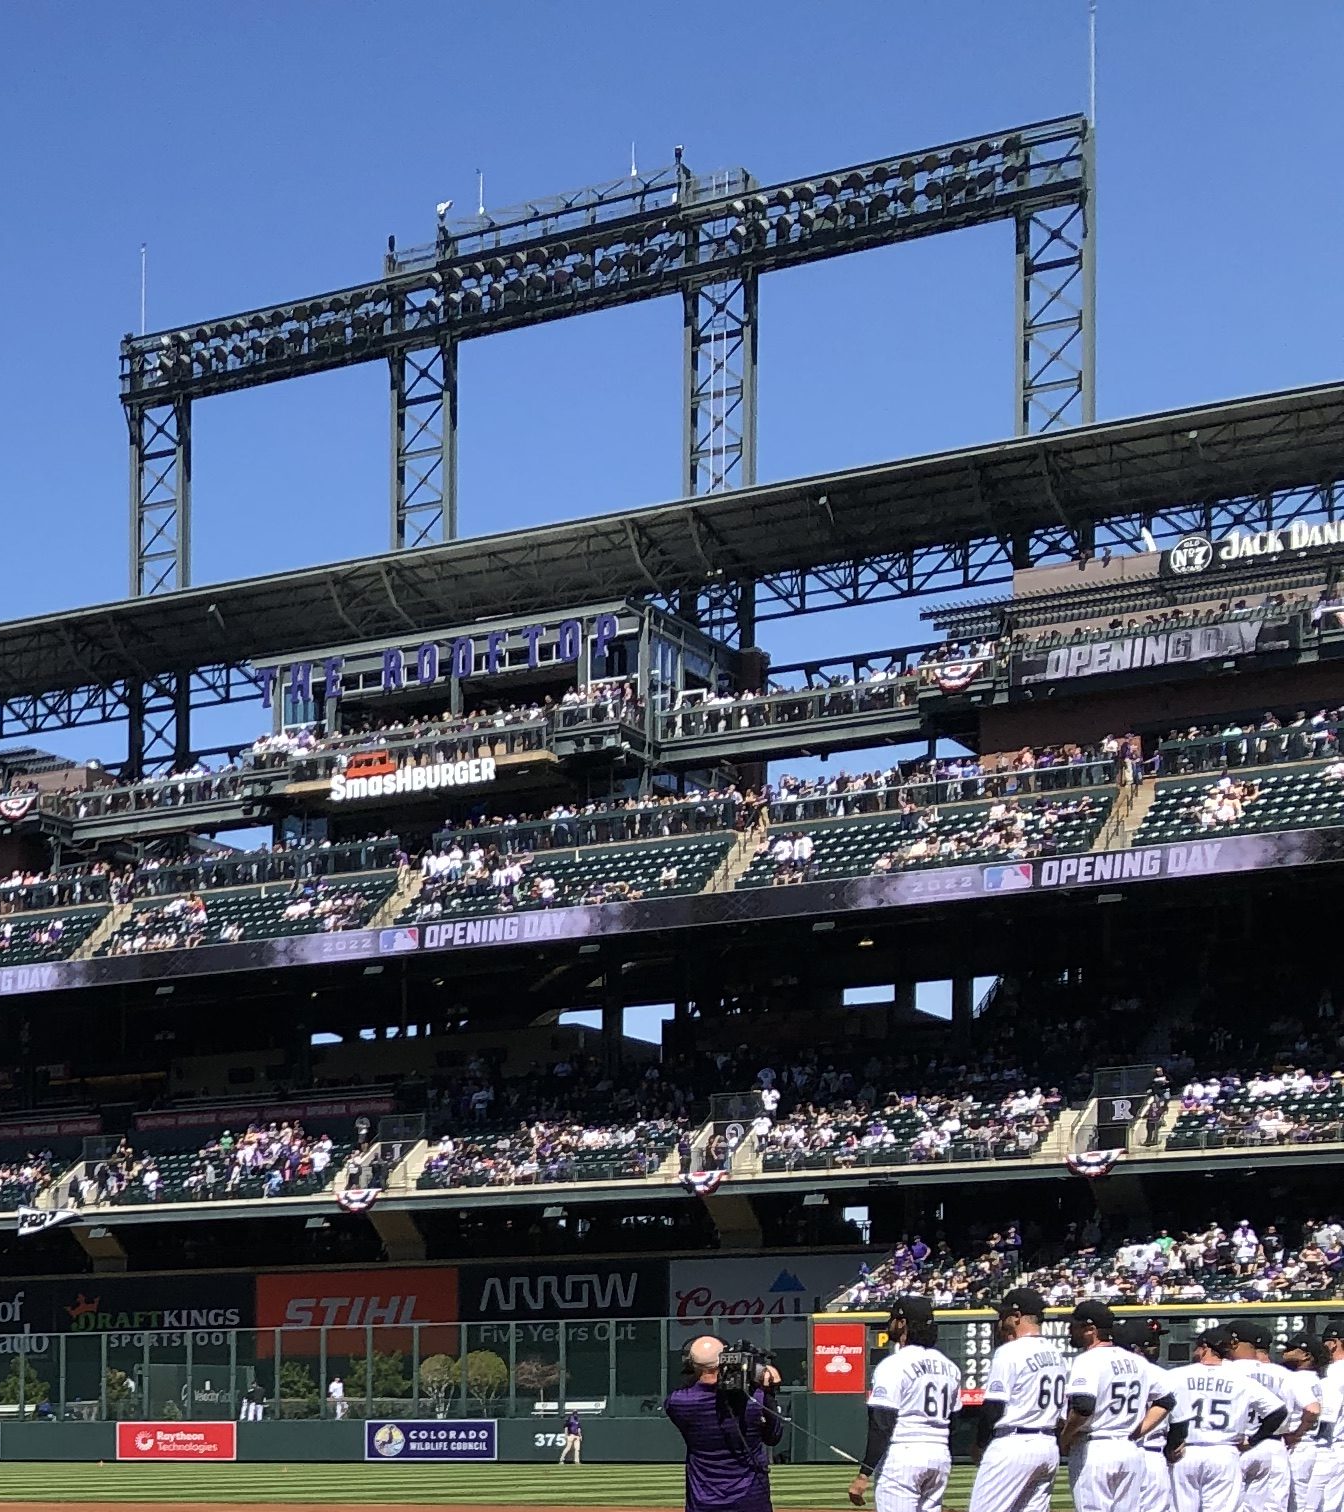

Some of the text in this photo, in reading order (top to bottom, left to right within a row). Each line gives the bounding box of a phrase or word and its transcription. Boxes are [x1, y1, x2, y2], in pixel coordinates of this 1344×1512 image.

[1218, 530, 1285, 561] JACK
[255, 614, 619, 709] THE ROOFTOP
[1045, 631, 1191, 680] OPENING
[912, 843, 1223, 893] 2022 OPENING DAY
[322, 912, 567, 953] 2022 OPENING DAY
[16, 965, 54, 990] DAY
[478, 1272, 639, 1312] ARROW
[280, 1294, 433, 1331] STIHL
[674, 1286, 786, 1327] Coors
[70, 1308, 241, 1332] DRAFTKINGS
[480, 1322, 637, 1343] Five Years Out
[965, 1322, 992, 1337] 53
[1276, 1315, 1305, 1331] 55
[877, 1332, 889, 1348] P
[965, 1340, 992, 1355] 35
[923, 1381, 949, 1418] 61
[1037, 1374, 1066, 1410] 60
[1109, 1379, 1142, 1415] 52
[156, 1430, 205, 1442] Raytheon
[157, 1441, 219, 1453] Technologies
[408, 1430, 489, 1440] COLORADO
[409, 1441, 488, 1451] WILDLIFE COUNCIL
[534, 1433, 567, 1447] 375
